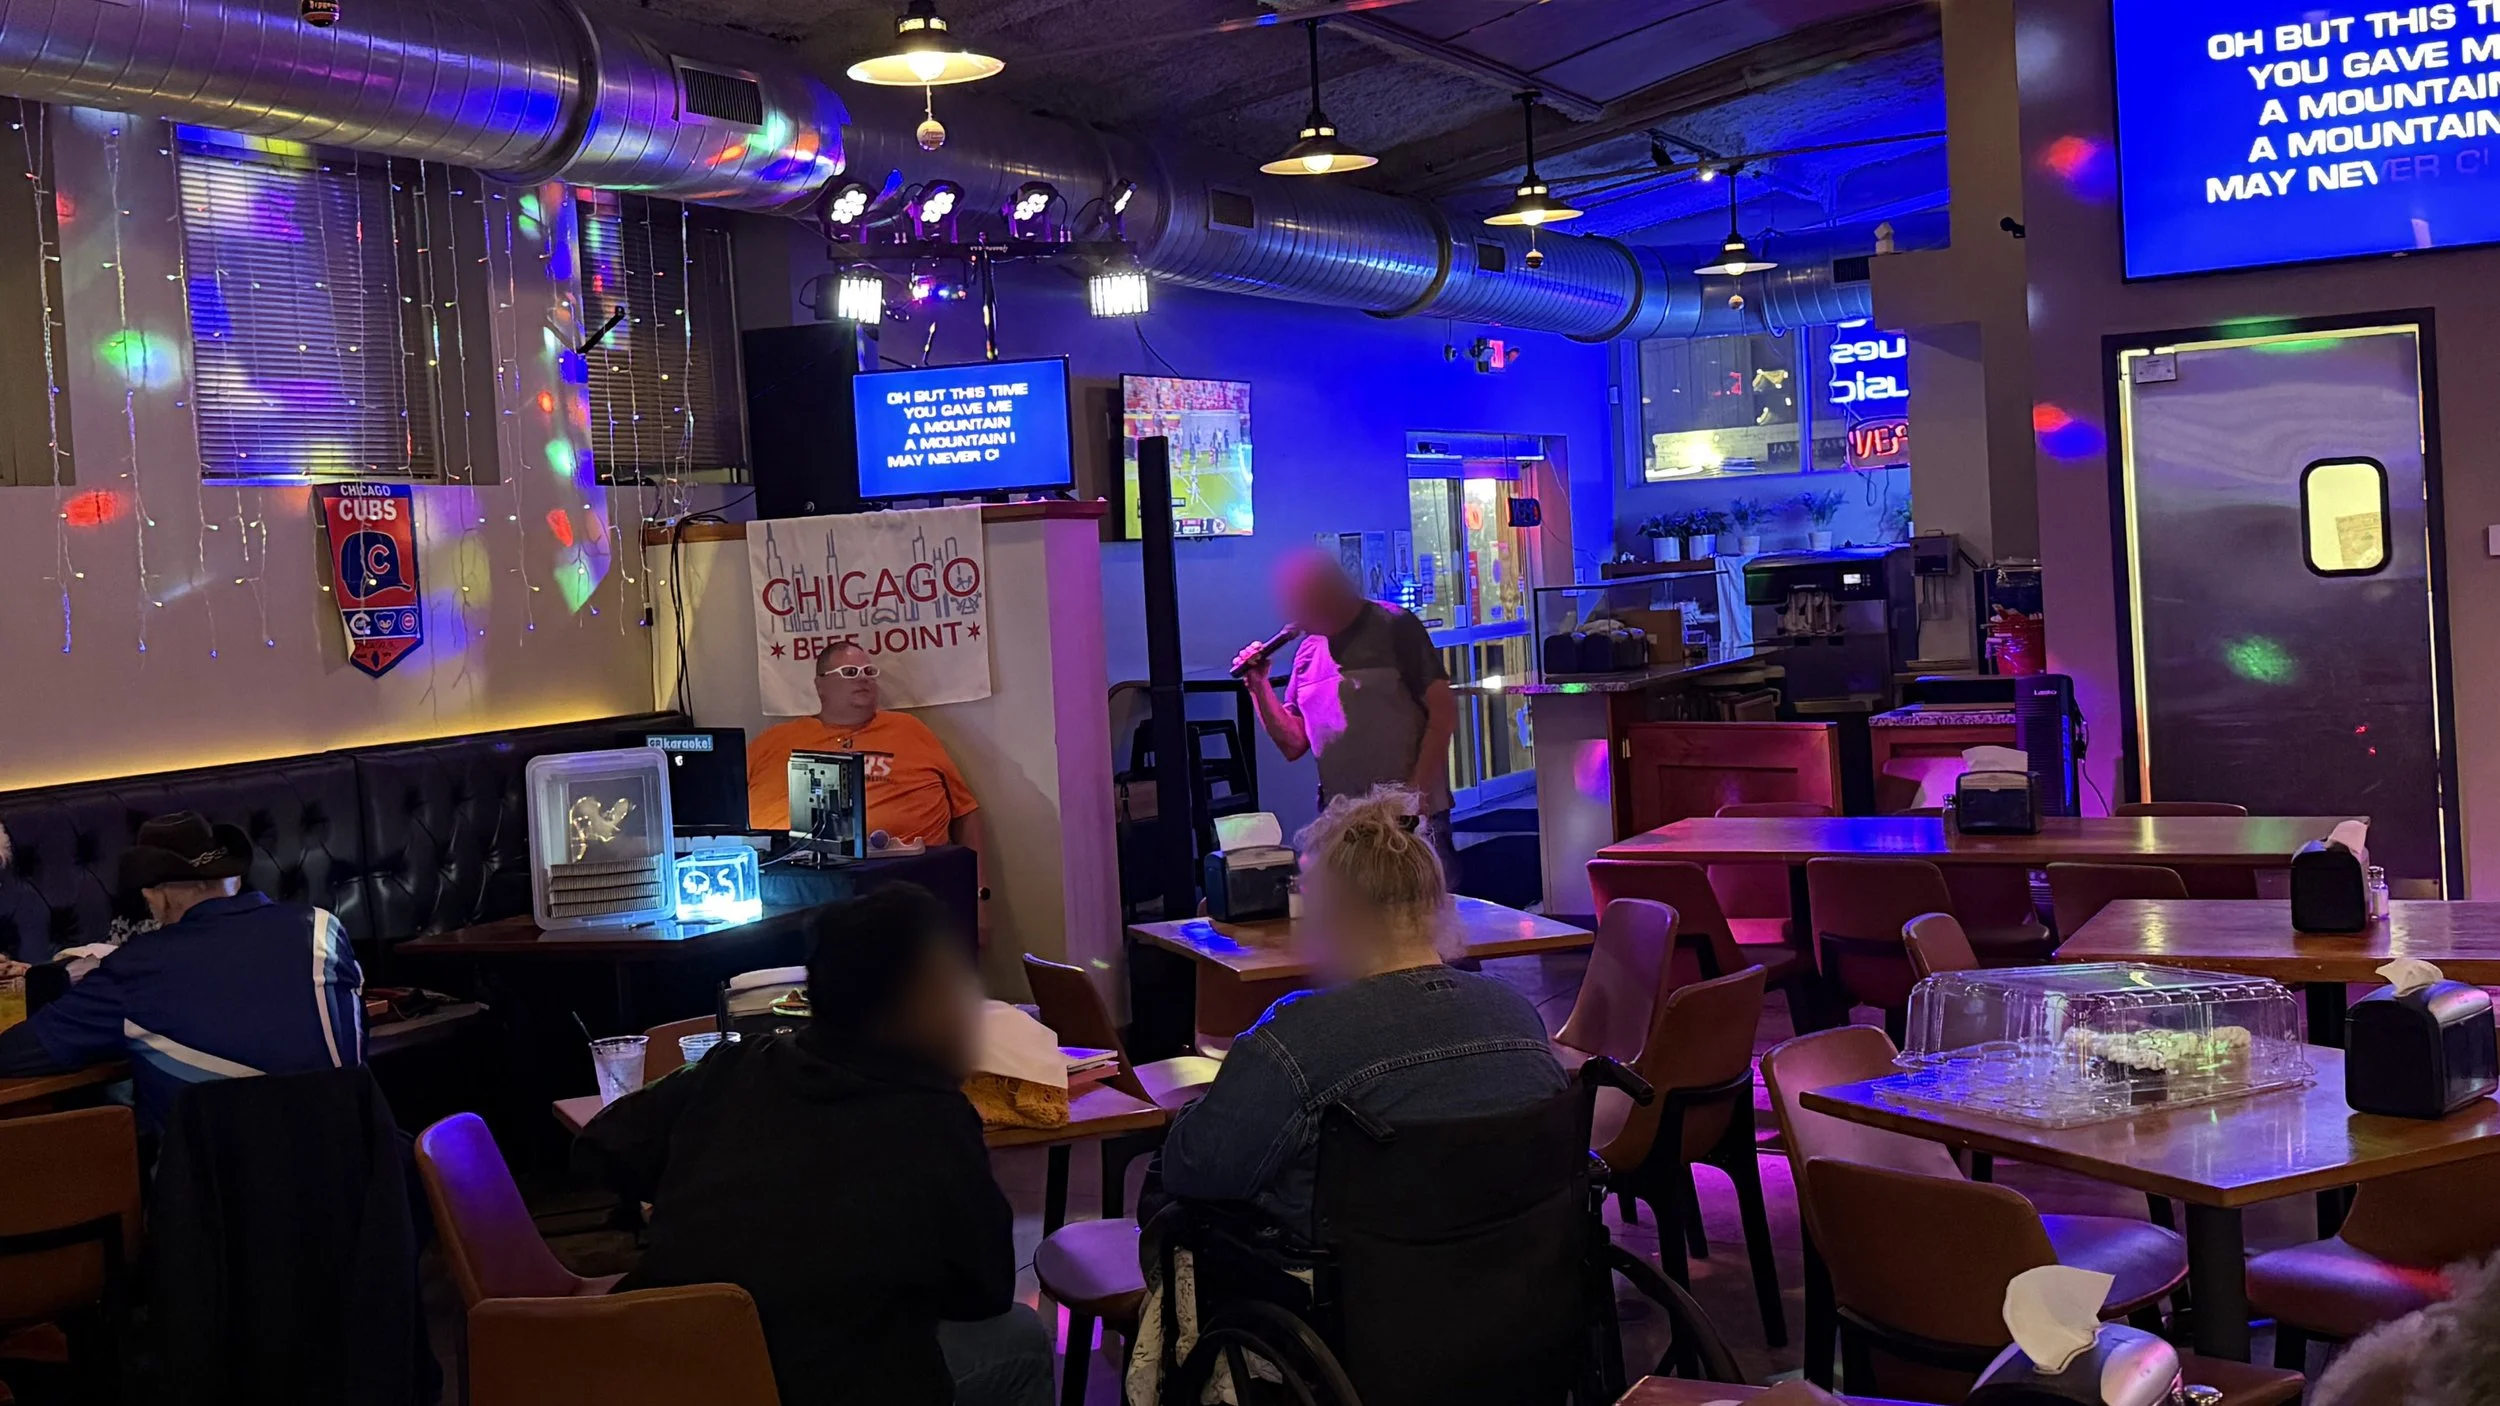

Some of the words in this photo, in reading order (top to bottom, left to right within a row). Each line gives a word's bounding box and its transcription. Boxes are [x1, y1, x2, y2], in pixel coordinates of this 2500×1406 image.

[2208, 29, 2263, 60] OH
[2275, 17, 2355, 51] BUT
[2364, 3, 2456, 39] THIS
[2247, 56, 2328, 90] YOU
[2342, 40, 2449, 78] GAVE
[2258, 99, 2288, 126] A
[2248, 136, 2278, 163] A
[2206, 168, 2296, 203] MAY
[2308, 154, 2440, 192] NEVER
[887, 391, 911, 405] OH
[914, 389, 946, 403] BUT
[949, 386, 986, 400] THIS
[989, 383, 1028, 397] TIME
[904, 406, 936, 419] YOU
[941, 402, 982, 417] GAVE
[987, 400, 1012, 413] ME
[908, 423, 921, 435] A
[924, 416, 1011, 434] MOUNTAIN
[904, 439, 917, 451] A
[920, 432, 1007, 450] MOUNTAIN
[1010, 431, 1016, 443] I
[887, 454, 924, 468] MAY
[928, 450, 981, 466] NEVER
[340, 485, 391, 497] CHICAGO
[338, 499, 397, 521] CUBS
[368, 544, 391, 575] C
[762, 557, 980, 616] CHICAGO
[868, 621, 962, 655] JOINT
